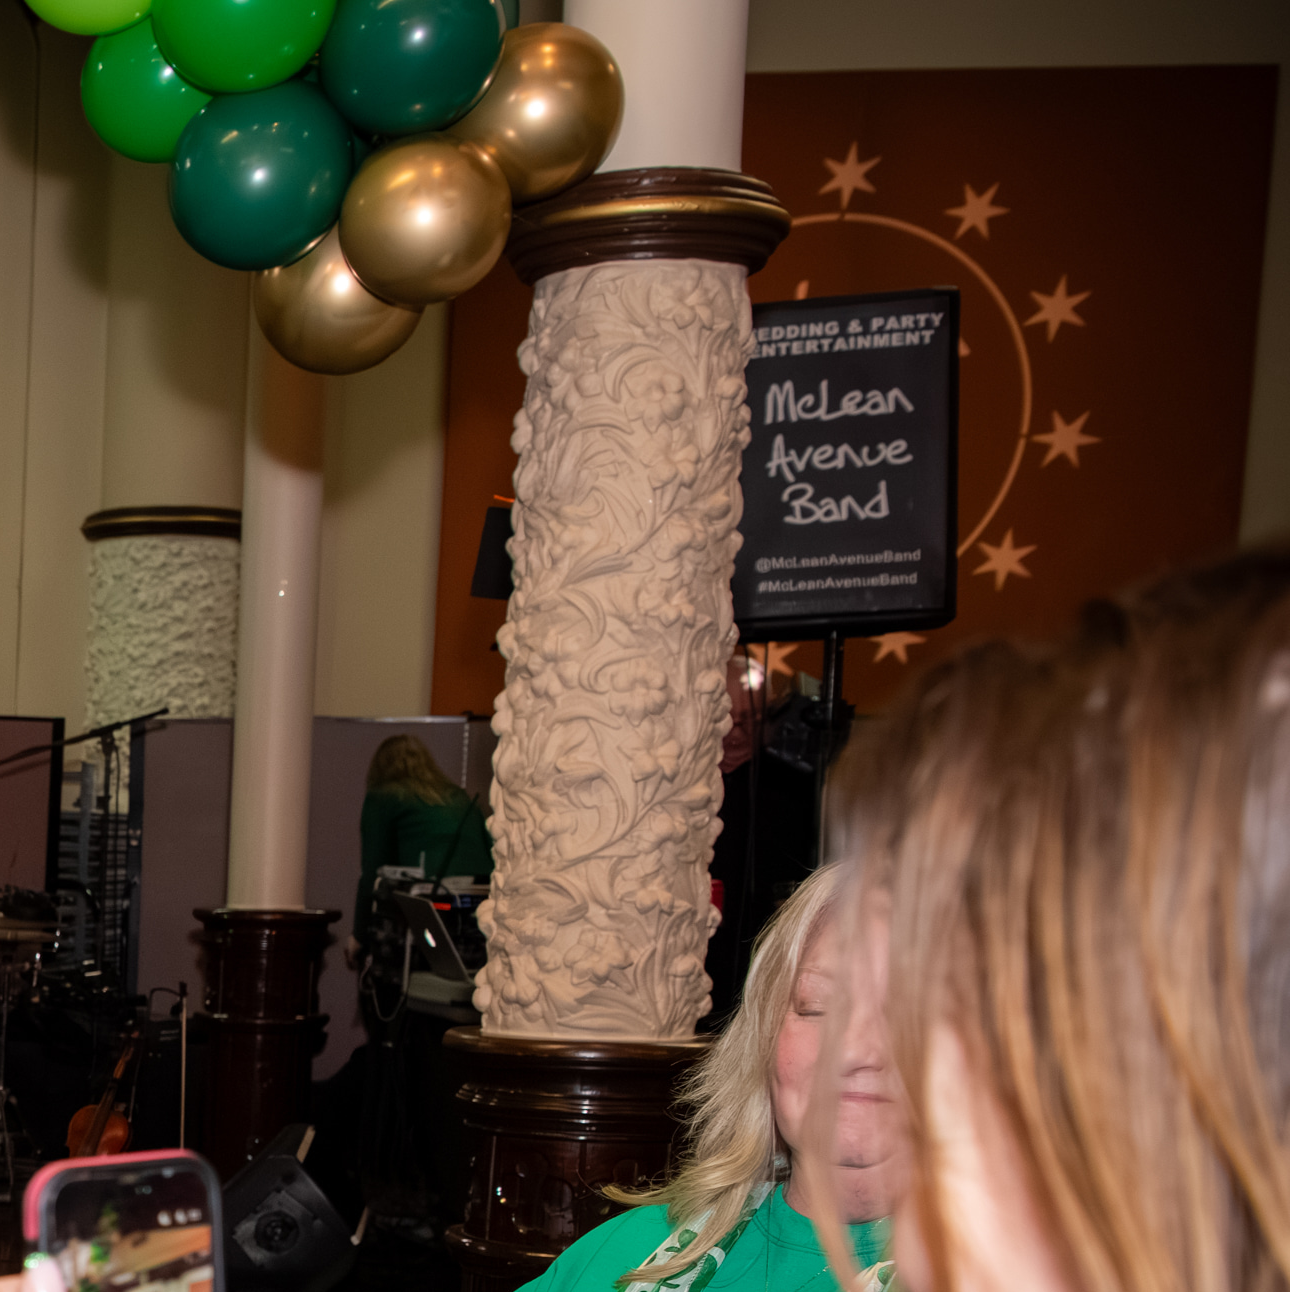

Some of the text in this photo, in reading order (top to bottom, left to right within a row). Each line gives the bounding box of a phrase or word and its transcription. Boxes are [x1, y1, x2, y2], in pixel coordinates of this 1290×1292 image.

[753, 312, 945, 342] EDDING & PARTY
[764, 379, 914, 425] McLean
[766, 433, 914, 482] Avenue
[782, 480, 890, 525] Band
[755, 549, 921, 573] @McLeanAvenueBand
[758, 572, 918, 593] #McLeanAvenueBand
